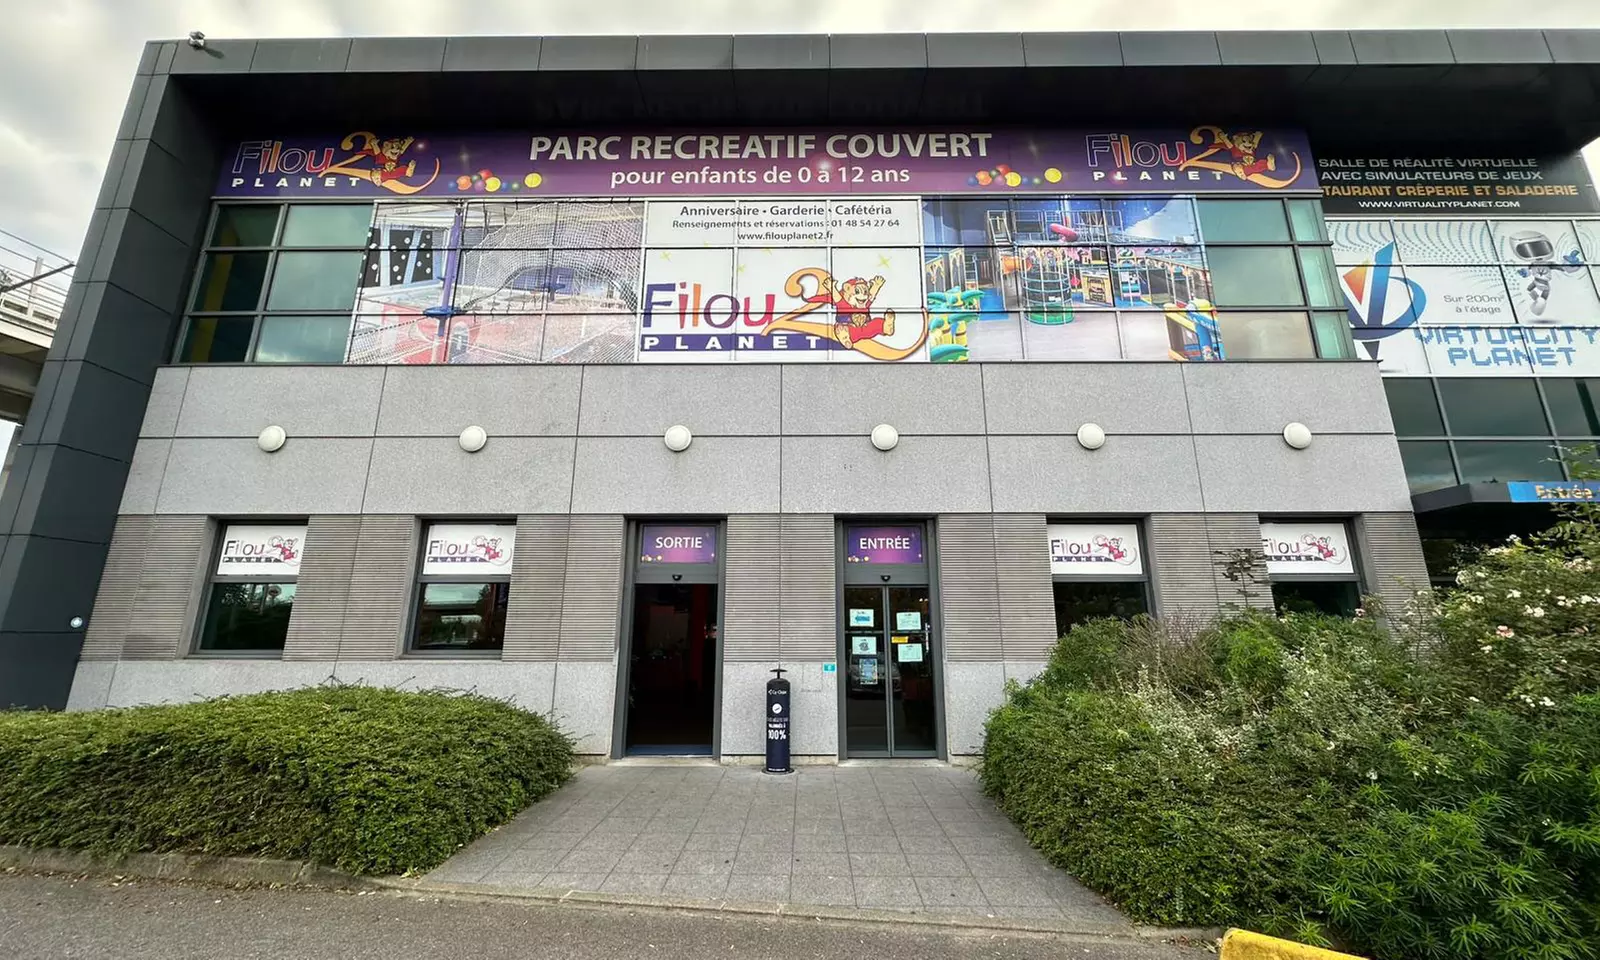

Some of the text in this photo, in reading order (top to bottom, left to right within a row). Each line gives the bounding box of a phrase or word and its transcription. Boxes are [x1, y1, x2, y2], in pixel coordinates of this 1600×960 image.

[529, 132, 993, 161] PARC RECREATIF COUVERT
[1085, 133, 1188, 168] Filou
[232, 140, 335, 175] Filou
[1318, 156, 1538, 168] SALLE DE RÉALITÉ VIRTUELLE
[231, 177, 361, 187] PLANET
[610, 169, 666, 189] pour
[676, 166, 758, 184] enfants
[763, 166, 793, 183] de
[797, 166, 812, 183] 0
[837, 166, 865, 183] 12
[870, 168, 911, 183] ans
[1093, 171, 1224, 181] PLANET
[1321, 171, 1544, 181] AVEC SIMULATEURS DE JEUX
[1319, 183, 1579, 196] TAURANT CRÊPERIE ET SALADERIE
[680, 204, 892, 216] Anniversaire Garderie Cafétéria
[1358, 201, 1521, 209] WWW.VIRTUALITYPLANET.COM
[672, 219, 752, 230] Renseignements
[753, 220, 763, 228] et
[765, 219, 825, 228] réservations
[831, 219, 842, 228] 01
[845, 219, 858, 228] 48
[860, 219, 872, 227] 54
[874, 219, 885, 227] 27
[887, 219, 900, 227] 64
[737, 230, 834, 241] www.filouplanet2.fr
[642, 281, 776, 329] Filou
[1443, 294, 1465, 303] Sur
[1455, 304, 1502, 314] à l'étage
[1413, 326, 1600, 345] VIRTUALITY
[643, 335, 822, 350] PLANET
[1447, 347, 1576, 366] PLANET
[224, 540, 265, 556] Filou
[428, 540, 469, 556] Filou
[655, 536, 703, 549] SORTIE
[859, 535, 911, 550] ENTRÉE
[1051, 539, 1092, 555] Filou
[768, 729, 787, 740] 100%
